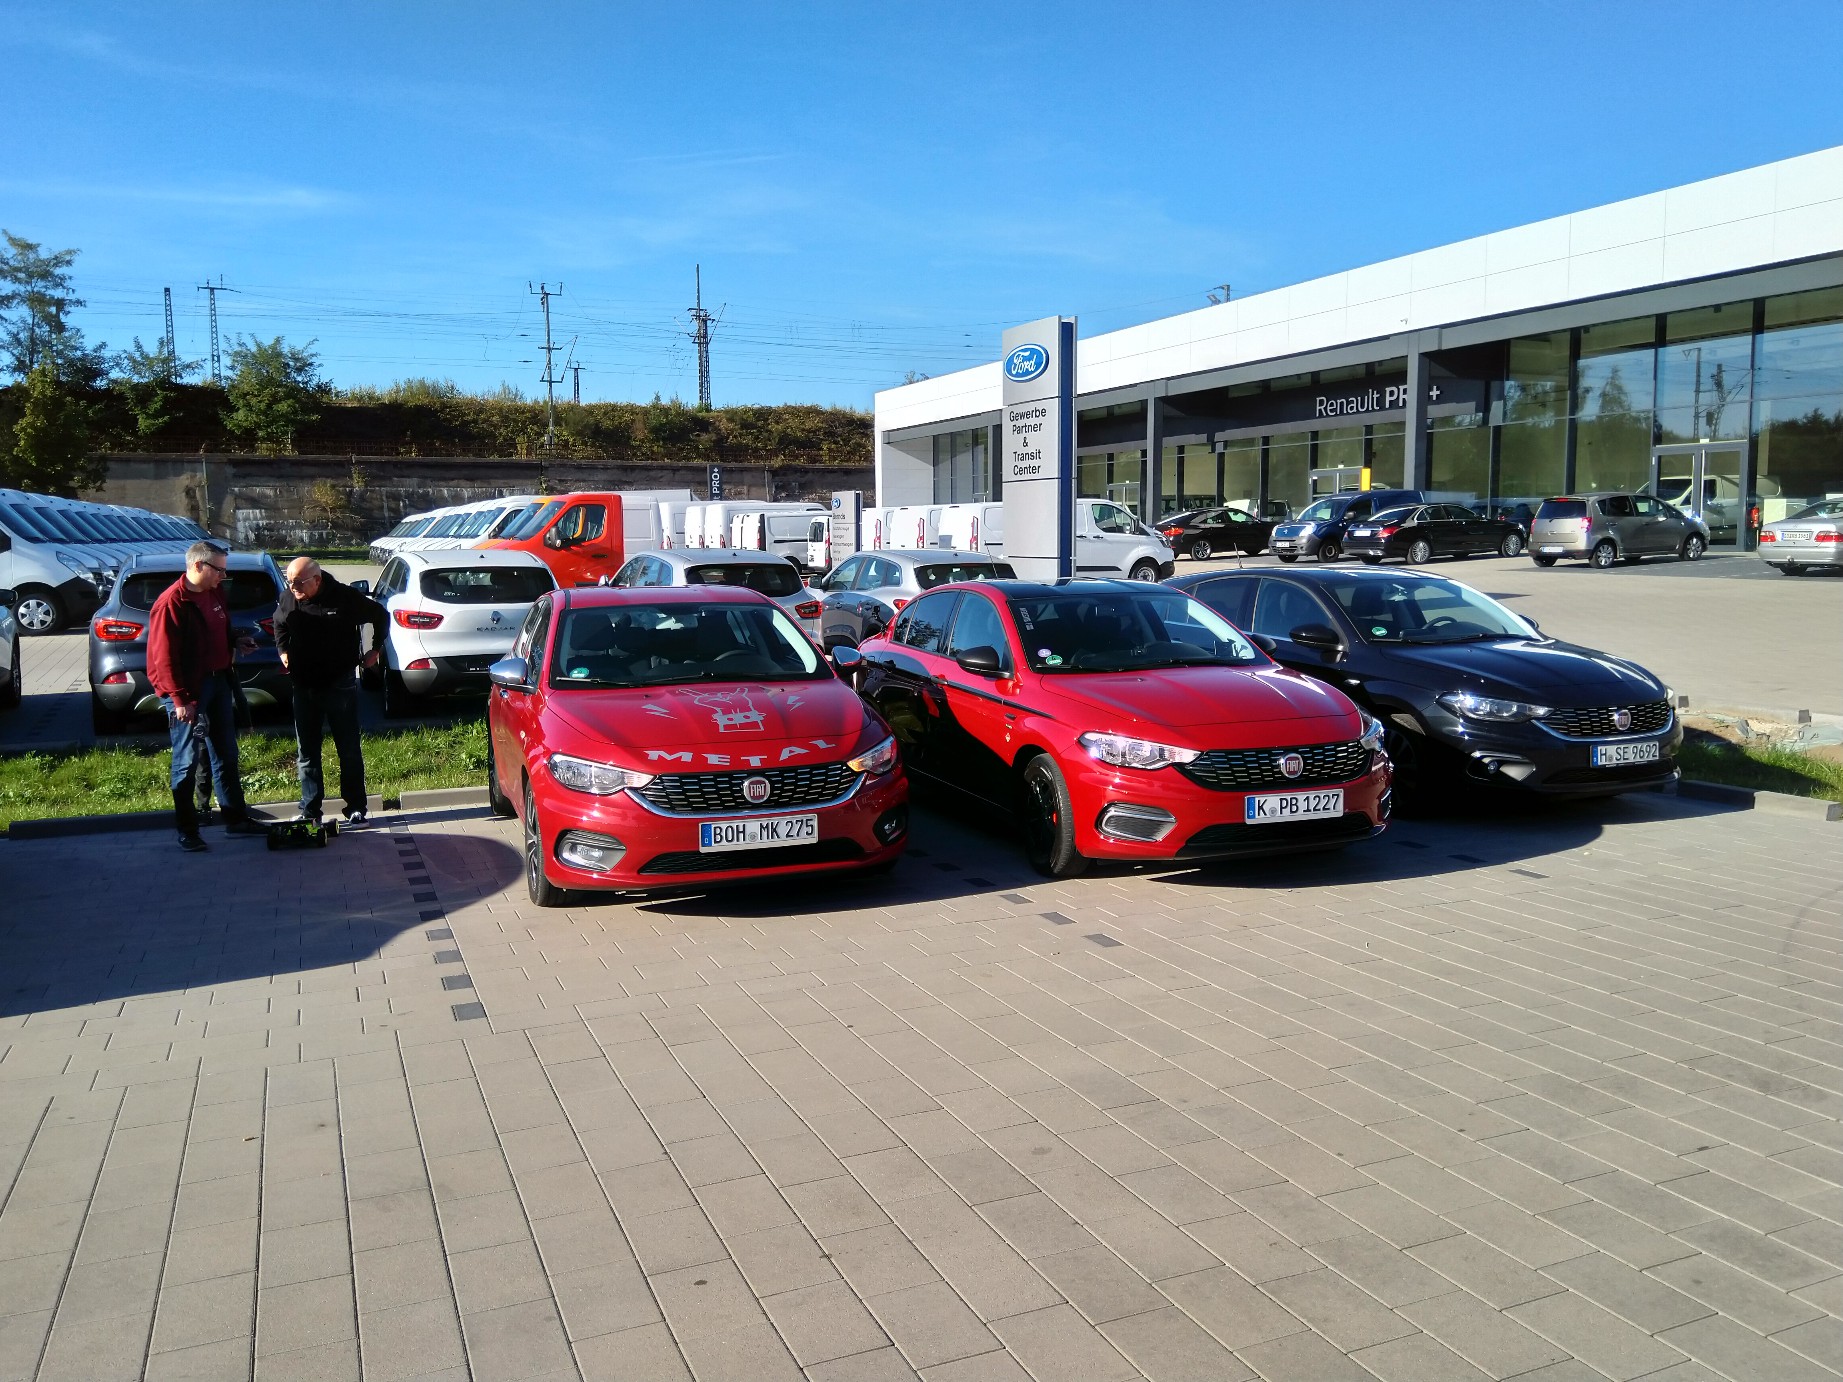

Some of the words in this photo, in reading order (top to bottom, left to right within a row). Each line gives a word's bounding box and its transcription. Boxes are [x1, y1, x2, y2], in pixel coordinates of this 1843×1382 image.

[1011, 350, 1037, 375] Ford
[1315, 389, 1381, 418] Renault
[1009, 406, 1047, 423] Gewerbe
[1012, 421, 1043, 435] Partner
[1022, 436, 1029, 448] &
[1013, 449, 1042, 463] Transit
[1013, 464, 1041, 476] Center
[643, 739, 836, 767] METAL
[1599, 748, 1607, 763] H
[1615, 746, 1629, 761] SE
[1631, 743, 1658, 760] 9692
[1286, 760, 1299, 772] FIAT
[749, 783, 766, 797] FIAT
[1257, 798, 1268, 817] K
[1279, 796, 1299, 815] PB
[1302, 793, 1340, 813] 1227
[713, 823, 746, 844] BOH
[759, 821, 780, 841] MK
[785, 818, 814, 838] 275
